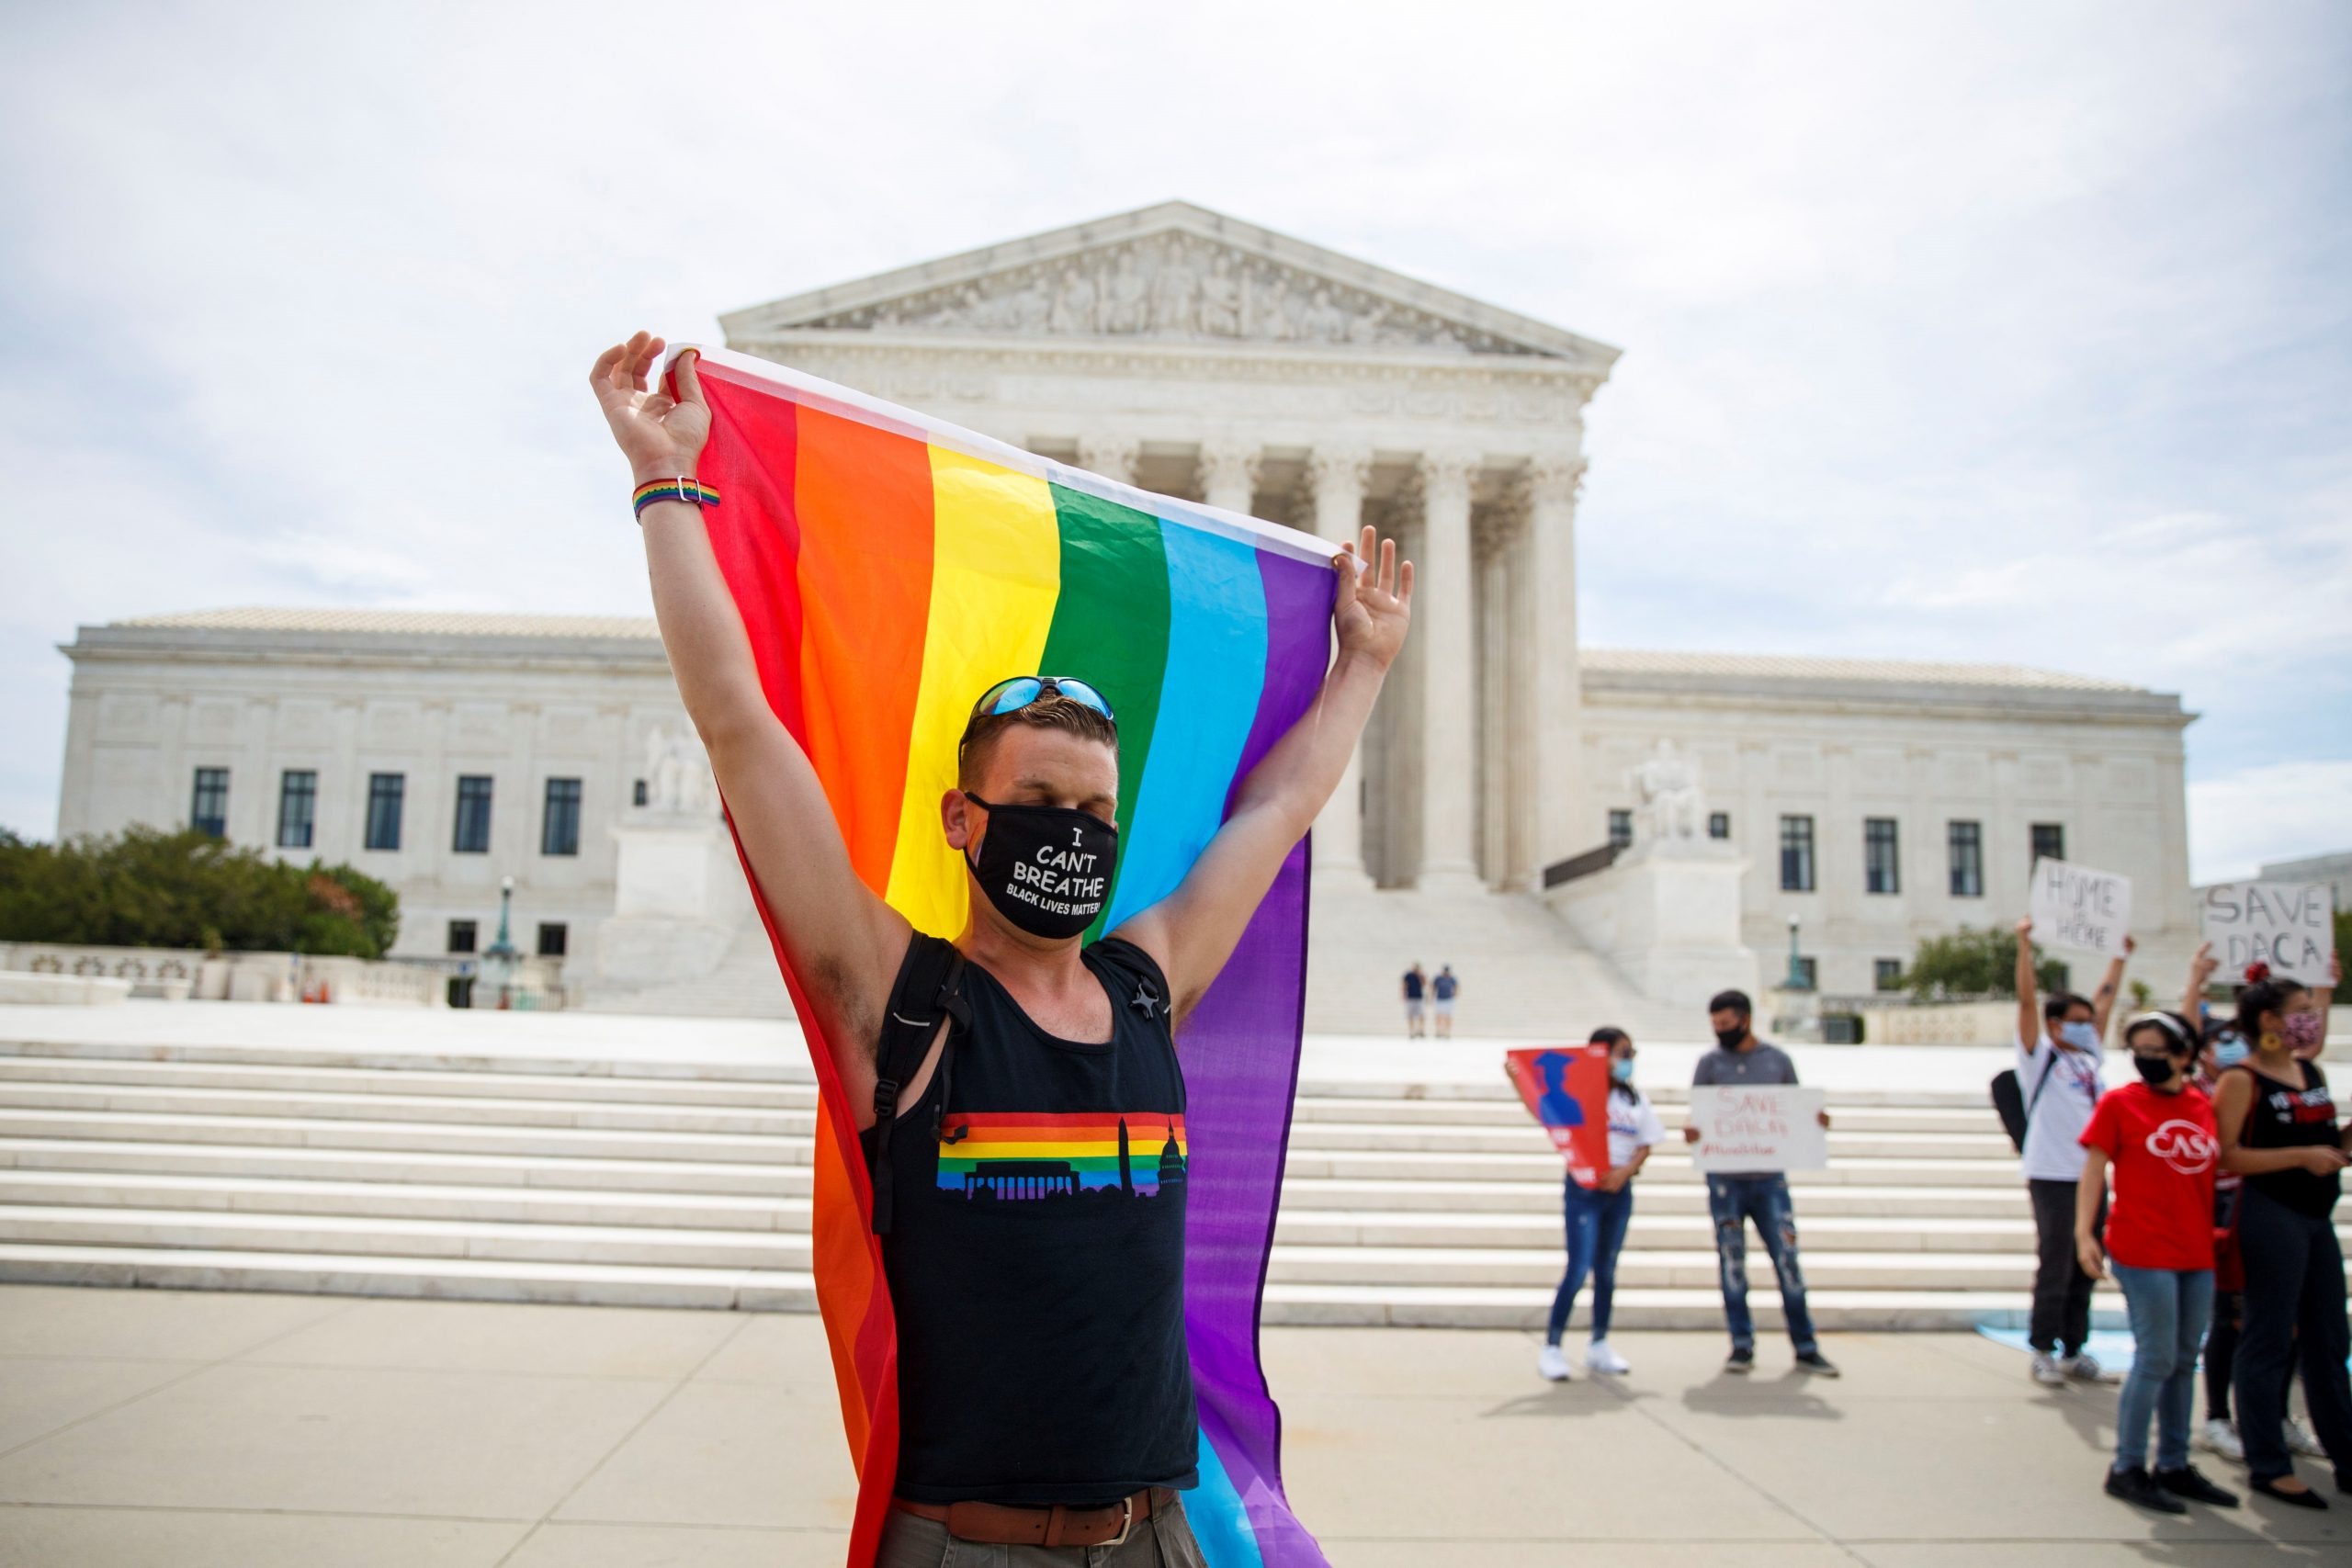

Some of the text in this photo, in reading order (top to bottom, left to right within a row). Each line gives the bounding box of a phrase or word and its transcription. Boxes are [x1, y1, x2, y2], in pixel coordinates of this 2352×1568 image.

[1071, 827, 1082, 847] I
[1036, 845, 1097, 874] CAN'T
[1013, 862, 1104, 898] BREATHE
[1006, 883, 1101, 916] BLACK LIVES MATTER!
[2207, 883, 2322, 927] SAVE
[2228, 931, 2323, 970] DACA
